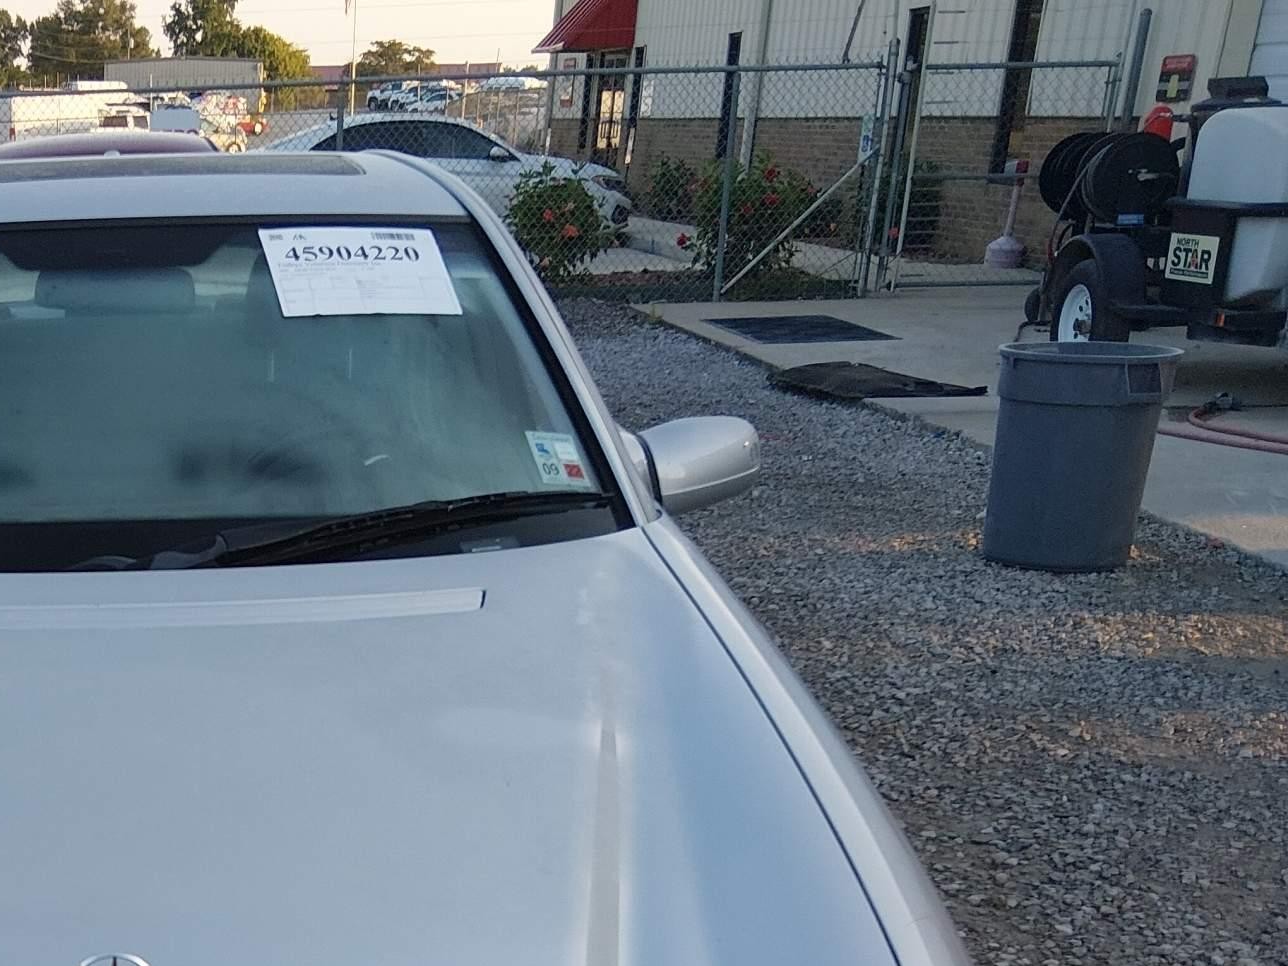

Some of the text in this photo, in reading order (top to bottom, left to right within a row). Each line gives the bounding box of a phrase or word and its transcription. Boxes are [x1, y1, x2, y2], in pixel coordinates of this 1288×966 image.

[1176, 237, 1200, 249] NORTH
[284, 244, 420, 262] 45904220
[1171, 246, 1212, 271] STAR
[541, 462, 560, 476] 09
